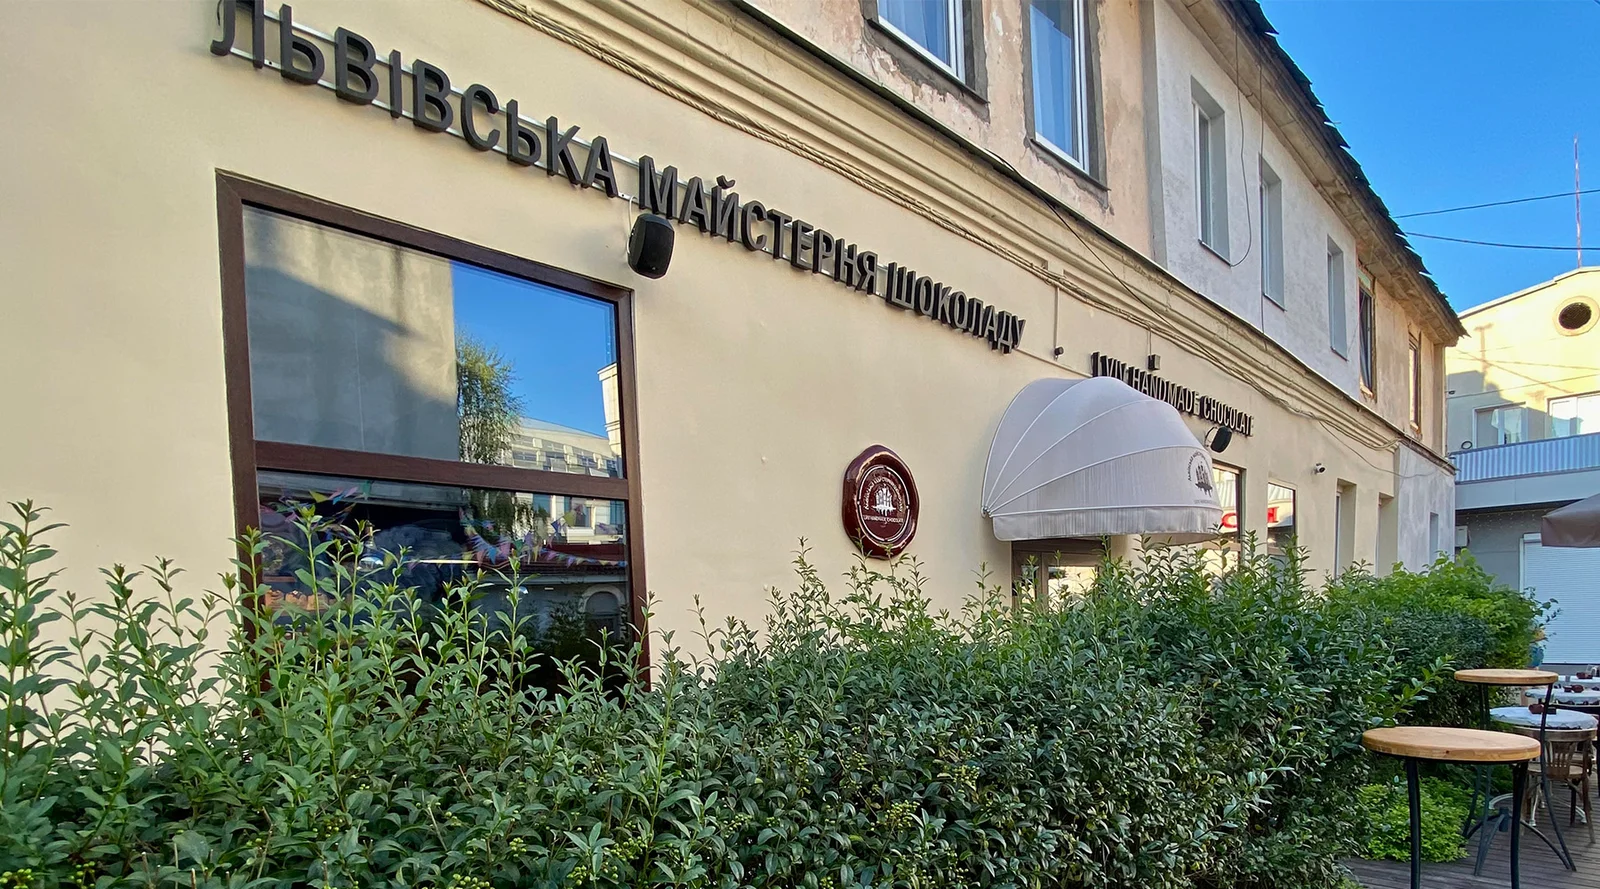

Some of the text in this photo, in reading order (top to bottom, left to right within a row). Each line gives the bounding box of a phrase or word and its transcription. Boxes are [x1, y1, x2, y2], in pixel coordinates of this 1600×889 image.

[210, 0, 1027, 354] ЛЬВІВСЬКА МАЙСТЕРНЯ ШОКОЛАДУ
[1128, 366, 1200, 416] HANDMADE
